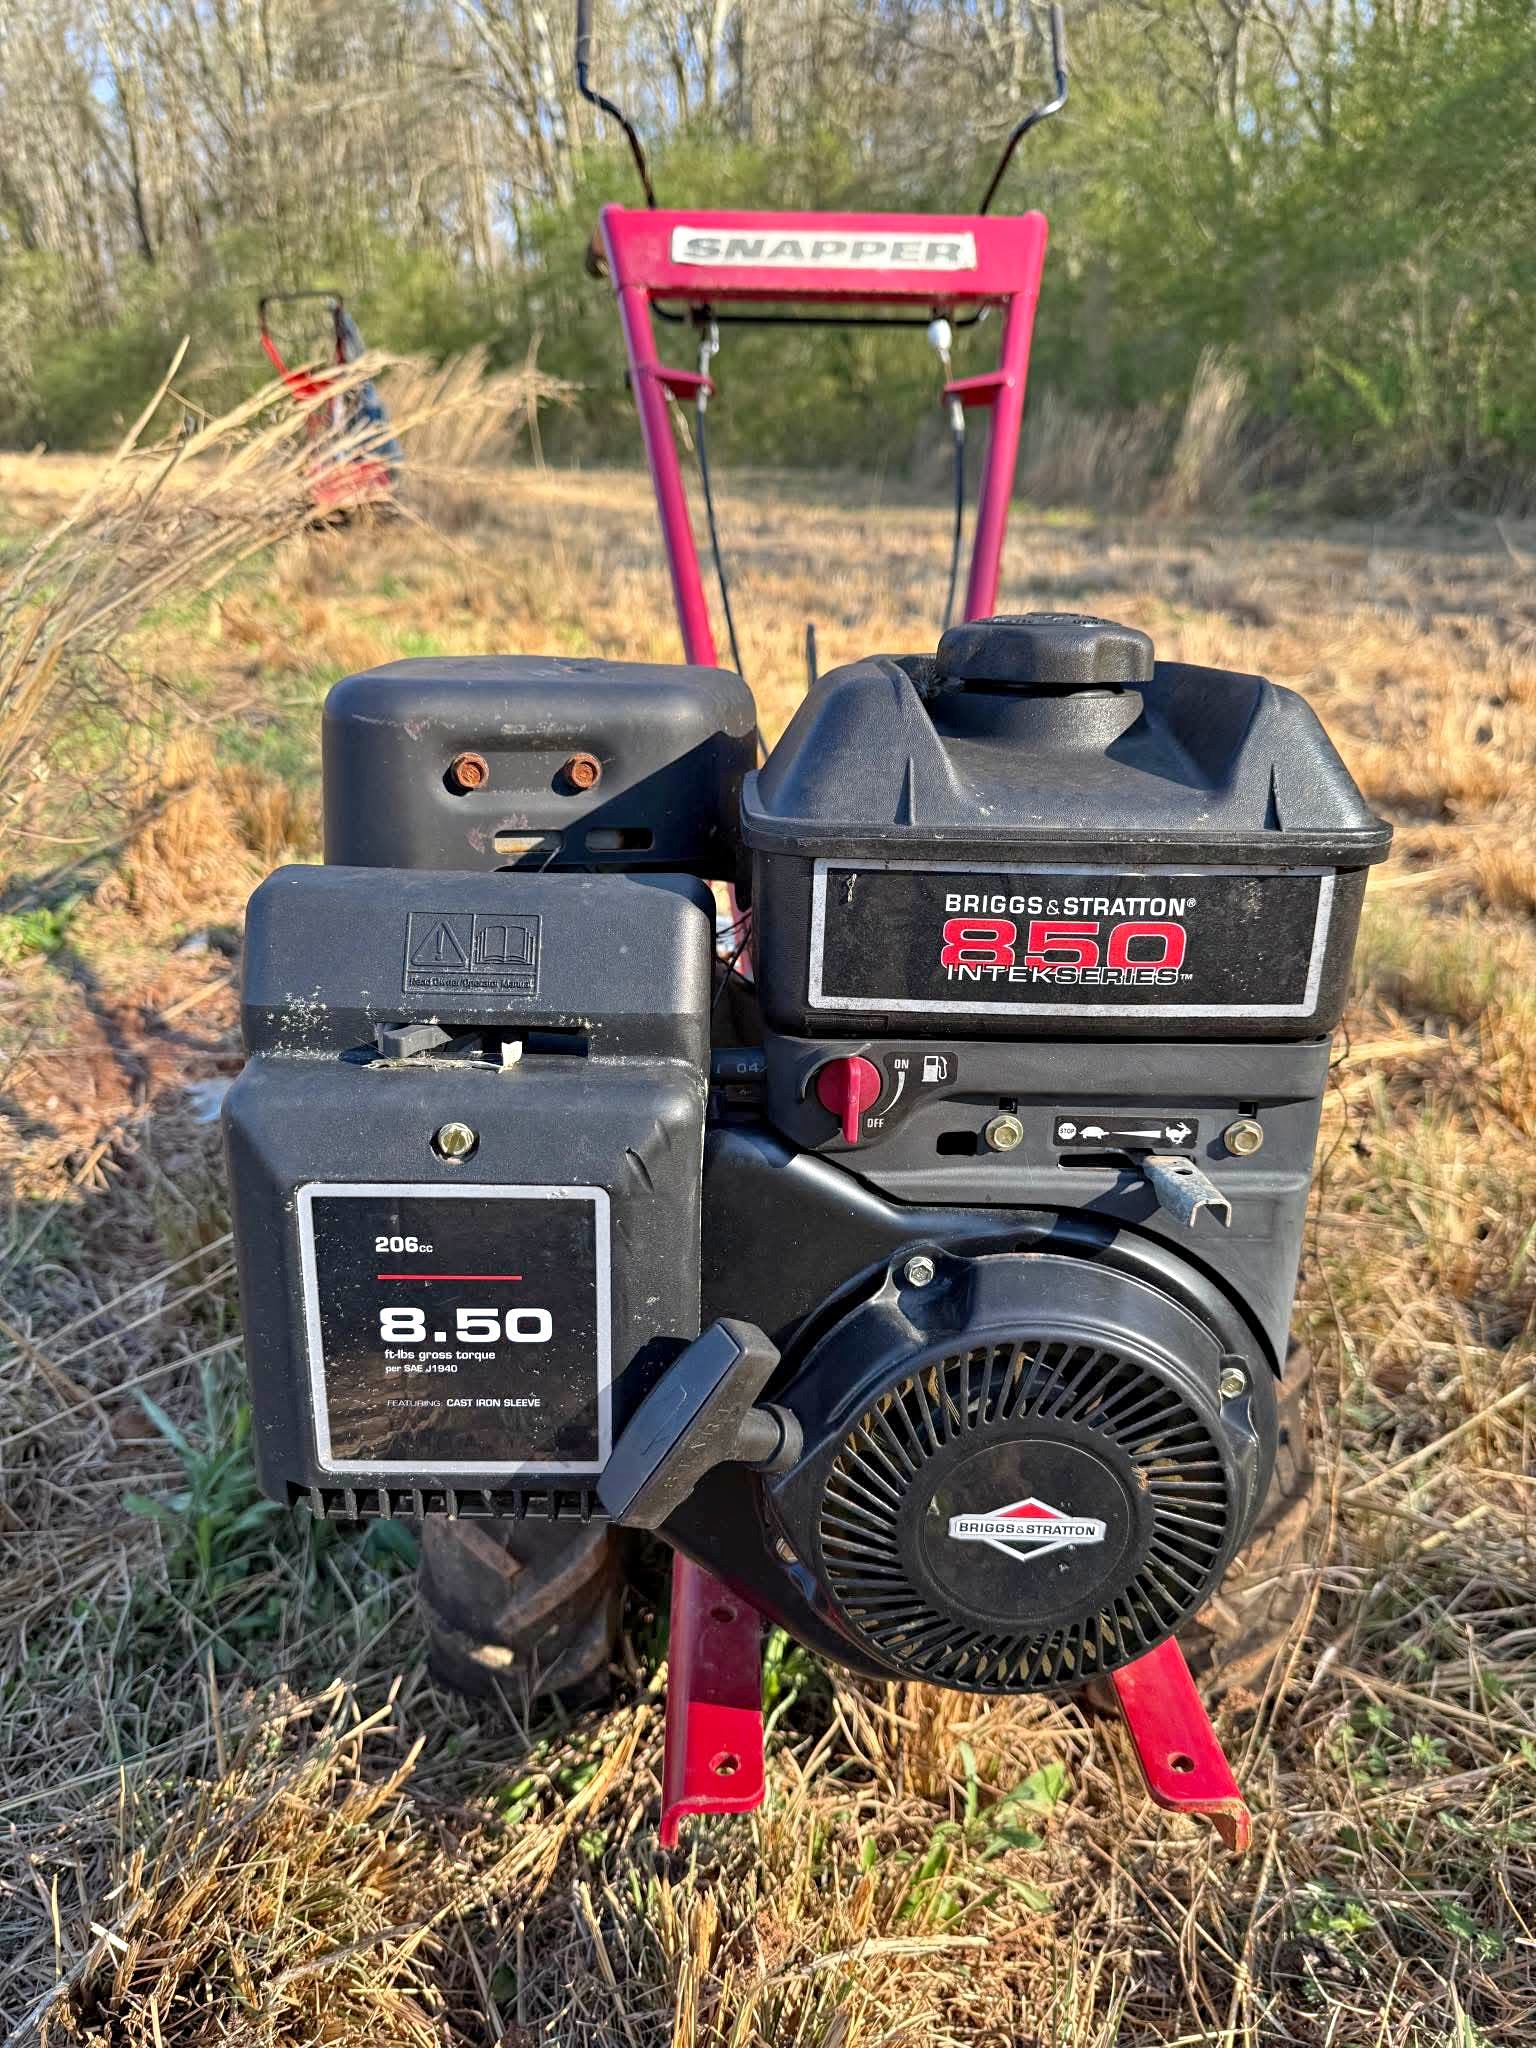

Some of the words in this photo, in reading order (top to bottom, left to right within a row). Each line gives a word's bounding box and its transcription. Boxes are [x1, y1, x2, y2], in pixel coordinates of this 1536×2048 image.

[683, 237, 962, 263] SNAPPER
[941, 917, 1188, 973] 850
[894, 1058, 910, 1070] ON
[867, 1118, 885, 1129] OFF
[1059, 1127, 1075, 1135] STOP
[375, 1236, 434, 1254] 206cc
[379, 1306, 554, 1344] 8.50
[384, 1349, 415, 1361] ft-lbs
[418, 1351, 453, 1362] gross
[456, 1350, 497, 1362] torque
[385, 1364, 402, 1374] per
[404, 1364, 424, 1373] SAE
[425, 1364, 458, 1374] J1940
[446, 1398, 473, 1408] CAST
[475, 1398, 501, 1408] IRON
[503, 1398, 542, 1408] SLEEVE
